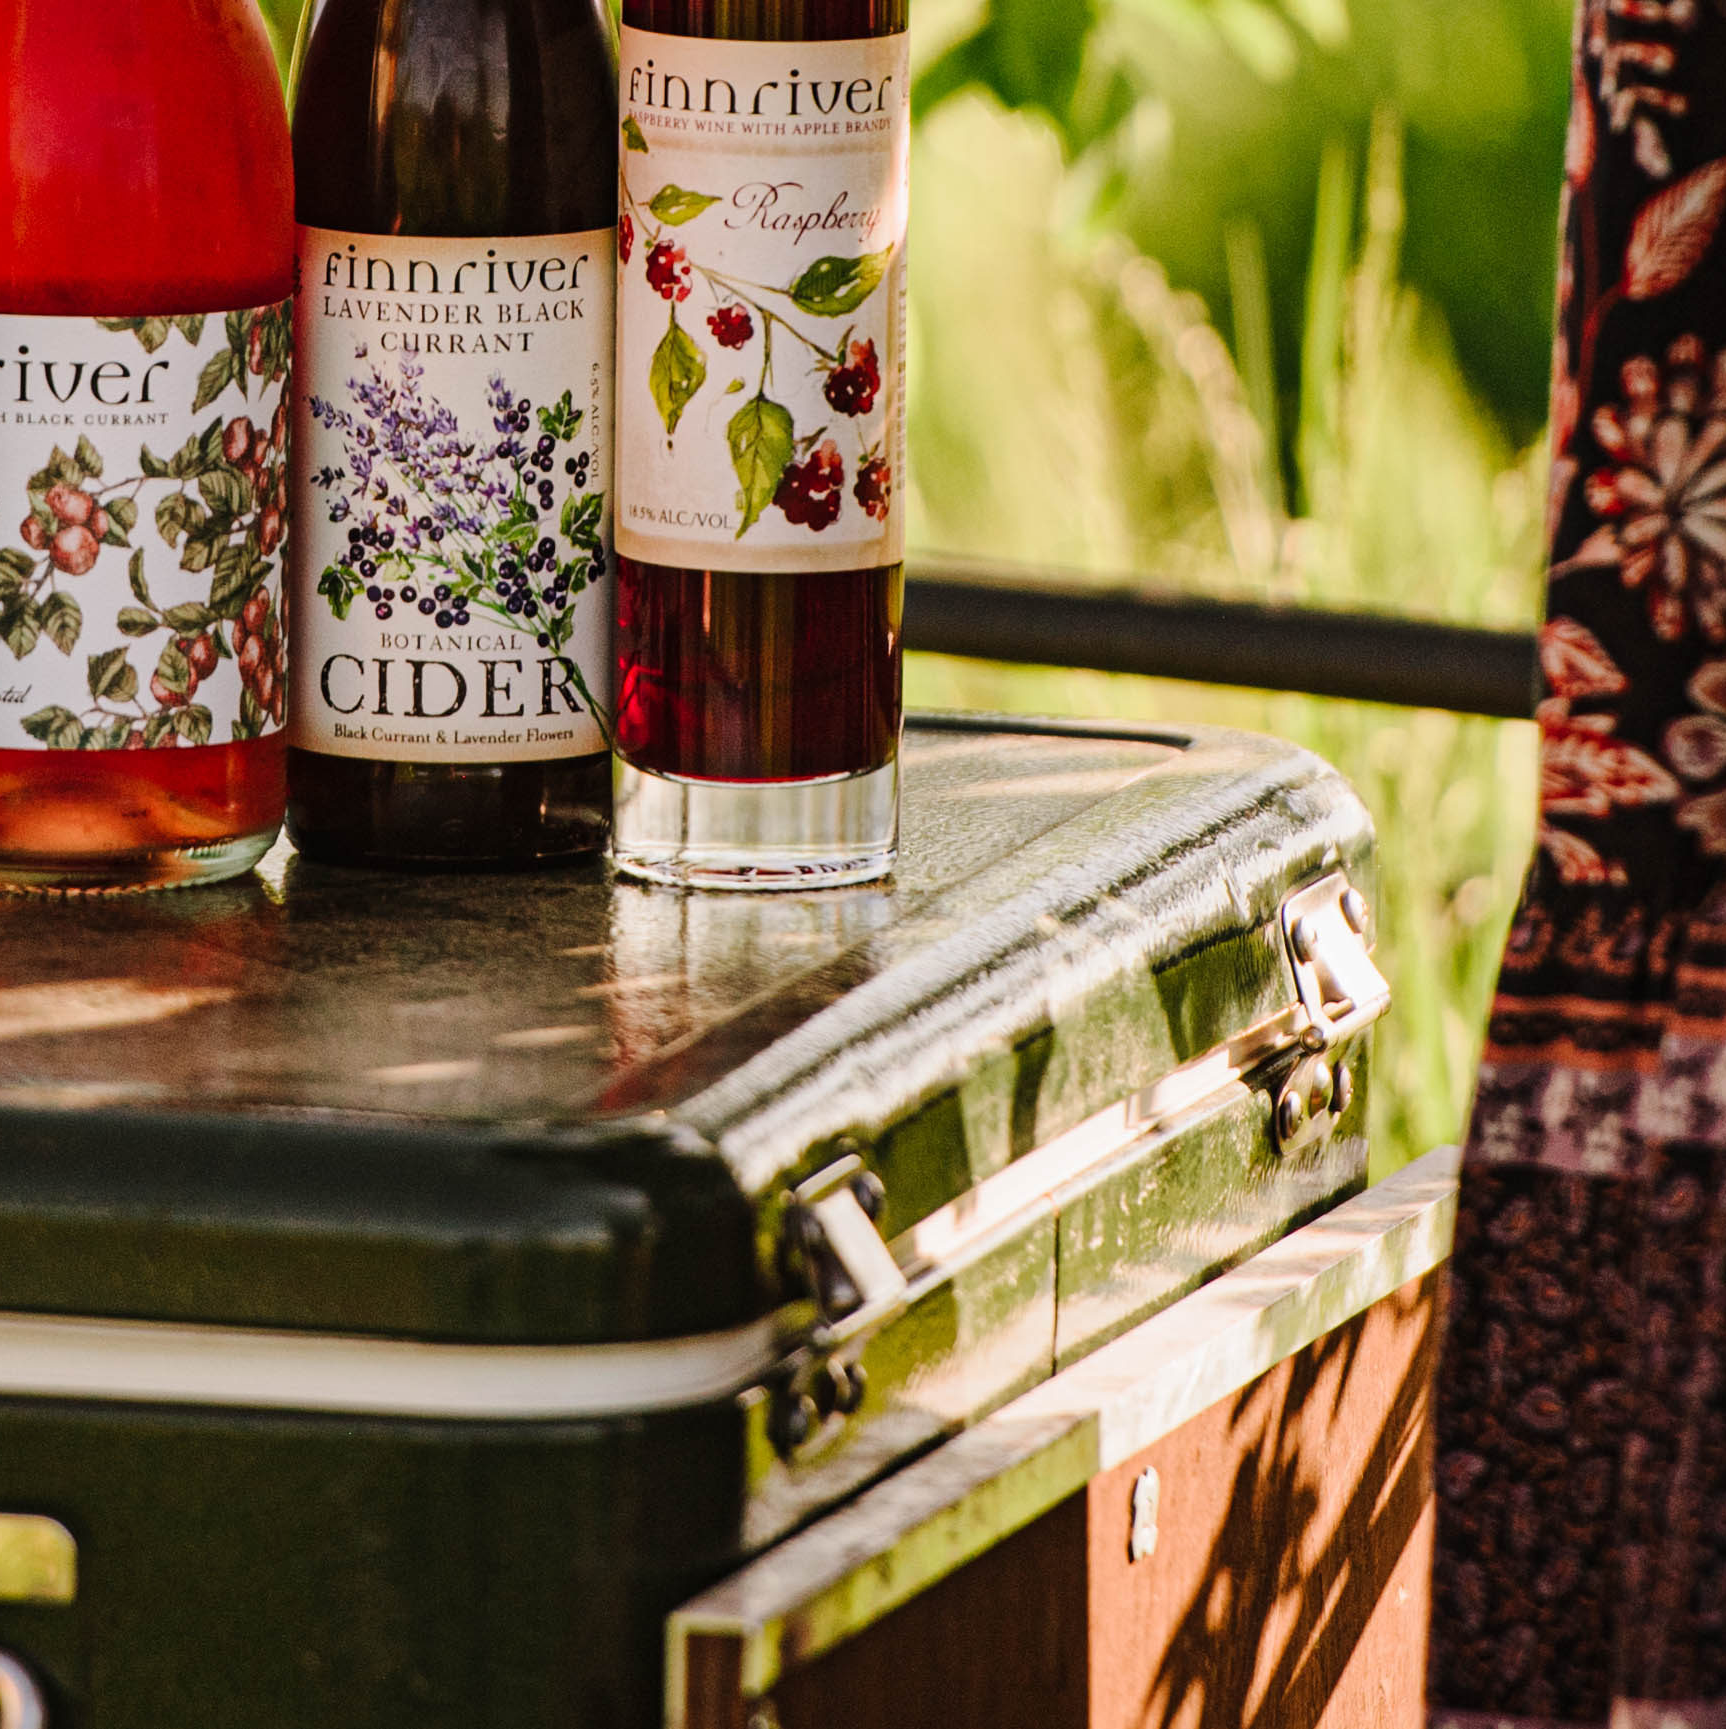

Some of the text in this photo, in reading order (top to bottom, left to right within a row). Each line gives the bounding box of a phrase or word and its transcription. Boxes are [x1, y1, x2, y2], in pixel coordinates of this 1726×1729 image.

[628, 58, 893, 116] finnriver
[695, 119, 734, 134] WINE
[742, 123, 786, 136] WITH
[792, 122, 840, 136] APPLE
[845, 117, 893, 134] BRANDY
[724, 181, 881, 246] Raspberry
[323, 244, 589, 294] finnriver
[323, 295, 585, 324] LAVENDER BLACK
[380, 331, 534, 354] CURRANT
[15, 412, 74, 425] BLACK
[83, 413, 169, 425] CURRANT
[380, 632, 523, 651] BOTANICAL
[320, 653, 585, 718] CIDER
[334, 723, 574, 745] Black Currant & Lavender Flowers
